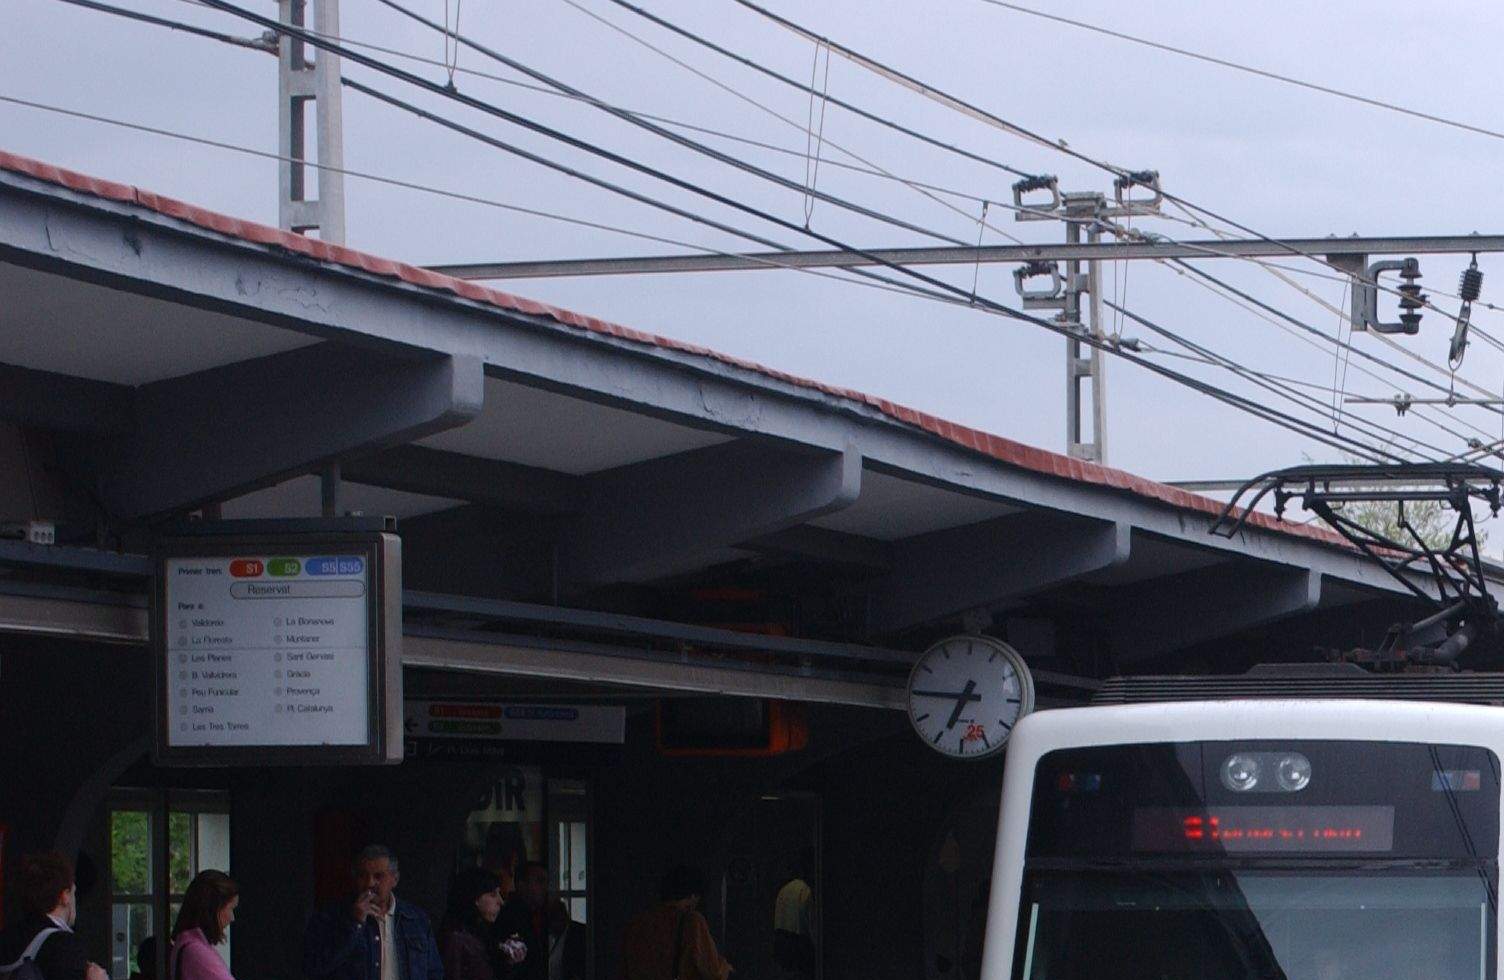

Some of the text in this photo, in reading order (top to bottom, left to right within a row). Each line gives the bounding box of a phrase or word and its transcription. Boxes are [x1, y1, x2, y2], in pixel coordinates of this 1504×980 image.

[246, 563, 259, 574] S1
[285, 563, 298, 574] S2
[248, 583, 290, 595] Reservat
[286, 617, 296, 625] La
